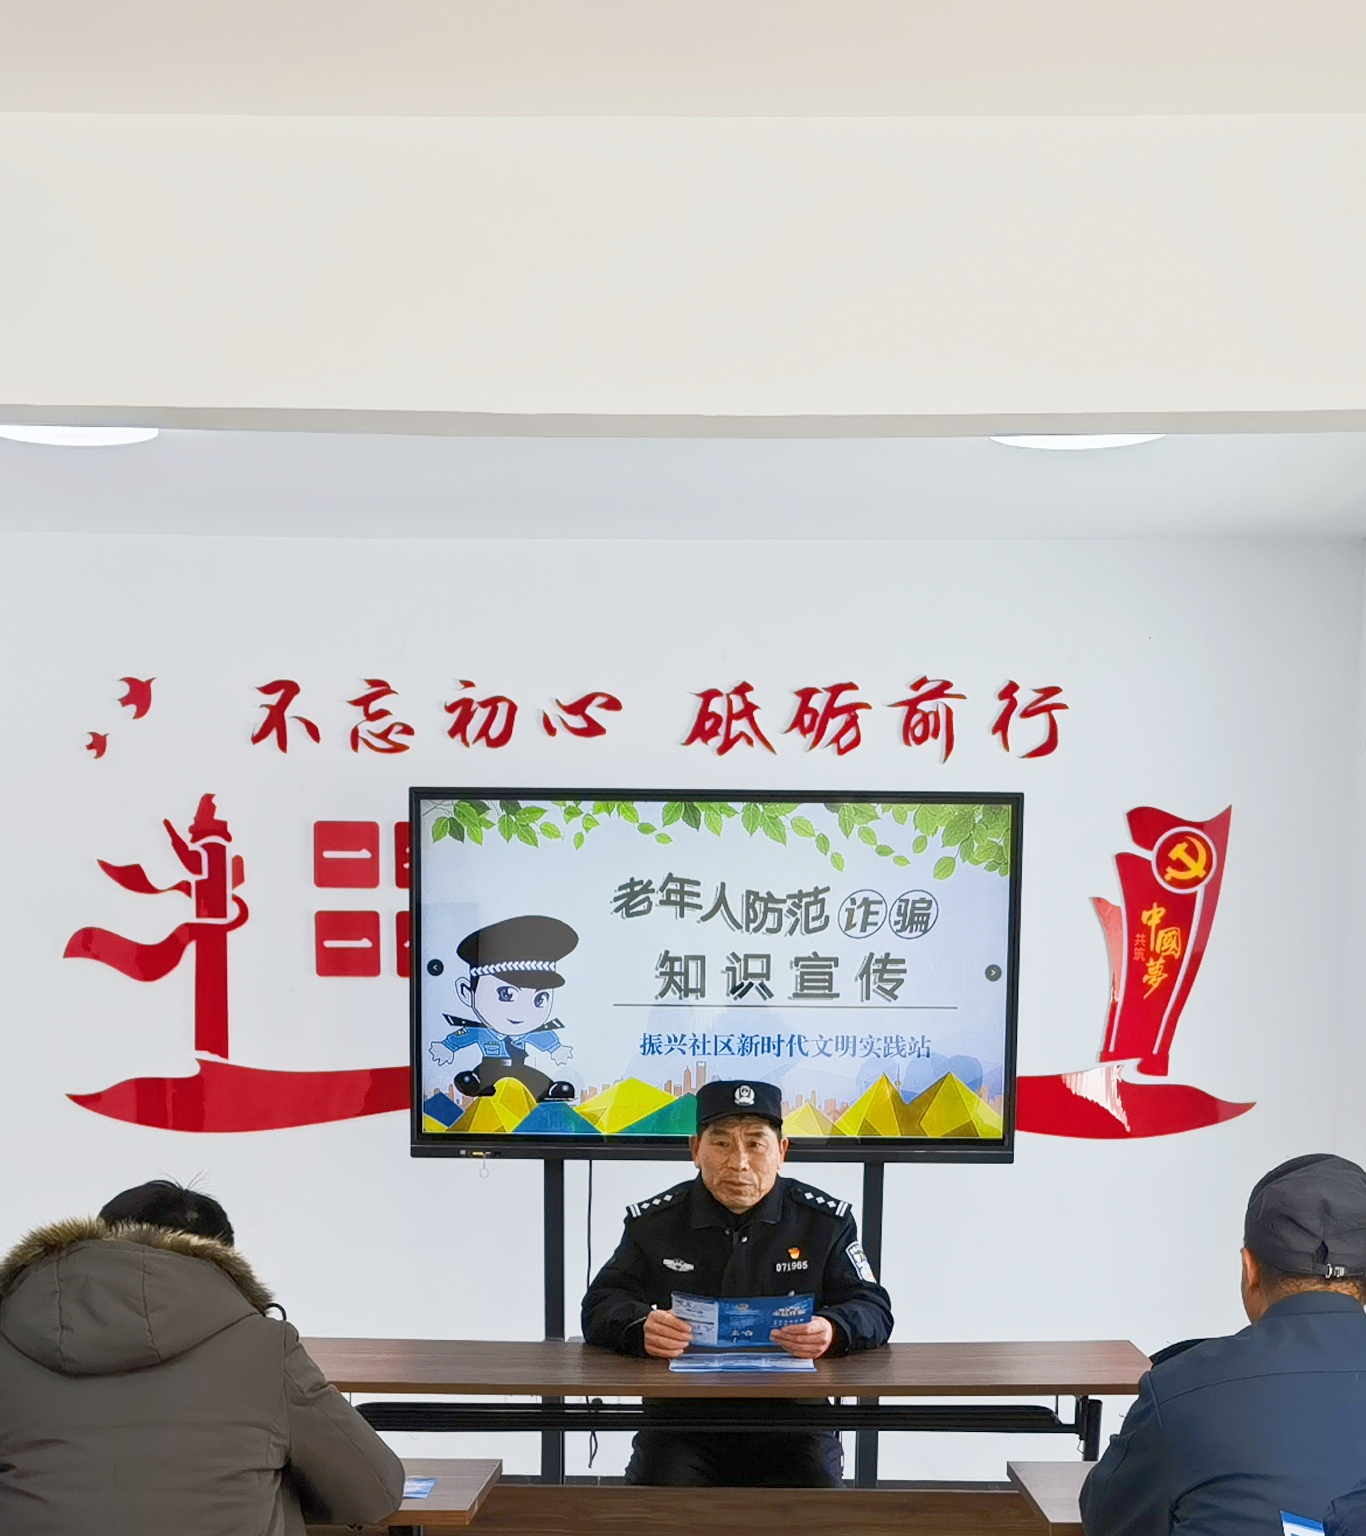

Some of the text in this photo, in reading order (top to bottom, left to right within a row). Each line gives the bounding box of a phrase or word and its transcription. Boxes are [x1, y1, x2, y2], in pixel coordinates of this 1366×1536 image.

[250, 675, 1069, 763] 不忘初心 砥砺前行
[610, 871, 939, 939] 老年人防范诈骗
[654, 949, 908, 1004] 知识宣传
[638, 1031, 933, 1060] 振兴社区新时代文明实践站
